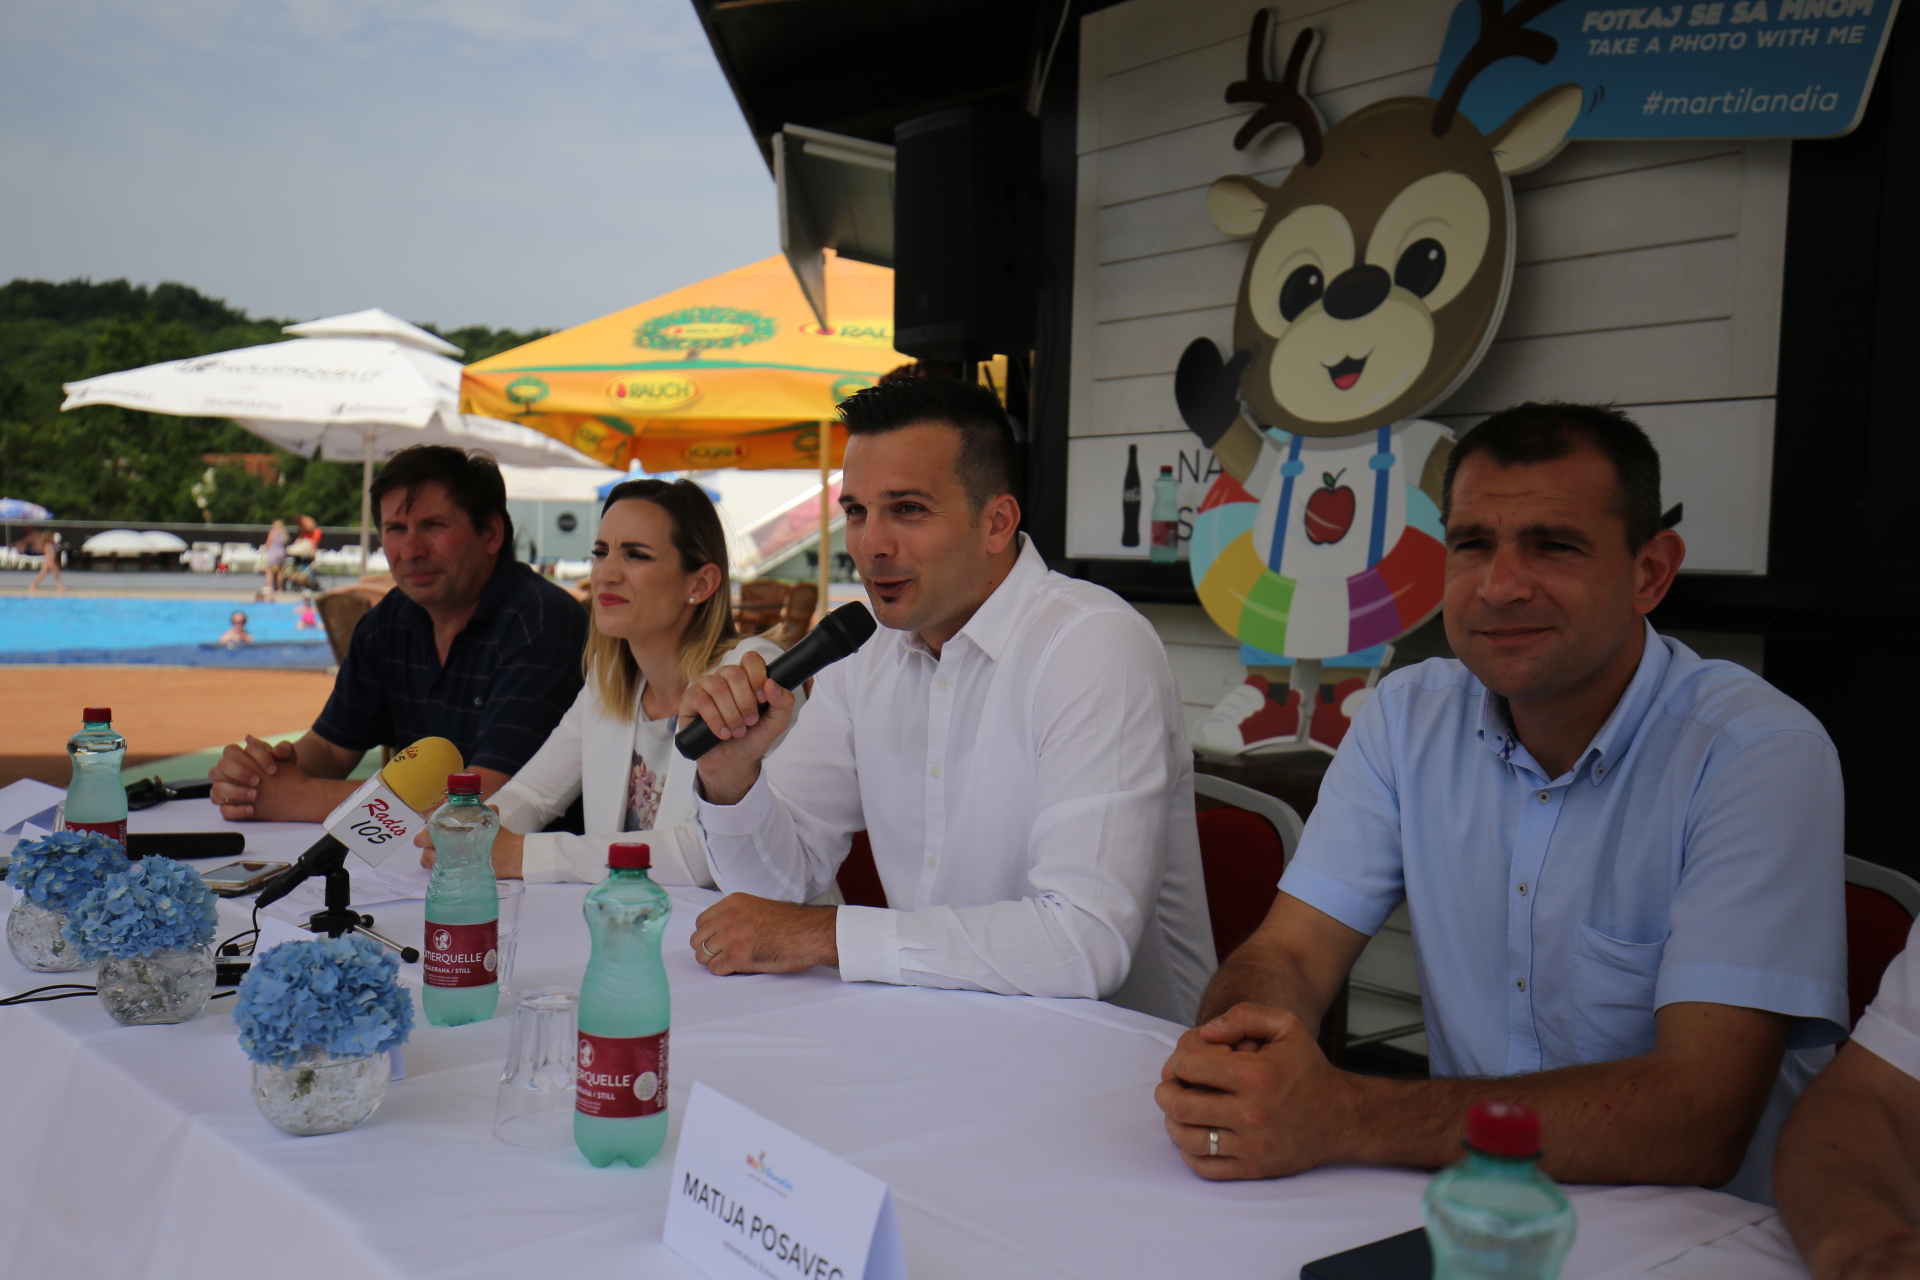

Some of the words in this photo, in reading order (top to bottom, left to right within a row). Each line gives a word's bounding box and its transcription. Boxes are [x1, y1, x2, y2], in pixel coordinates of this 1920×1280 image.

[1581, 5, 1683, 32] FOTKAJ
[1688, 3, 1725, 27] SE
[1730, 1, 1768, 23] SA
[1777, 0, 1875, 21] MNOM
[1588, 37, 1640, 56] TAKE
[1644, 35, 1661, 53] A
[1669, 31, 1748, 52] PHOTO
[1757, 28, 1820, 48] WITH
[1826, 25, 1866, 45] ME
[1642, 86, 1839, 115] #martilandia
[629, 381, 690, 399] RAUCH
[350, 820, 393, 844] 105
[362, 798, 407, 837] Radio
[682, 1171, 745, 1234] MATIJA
